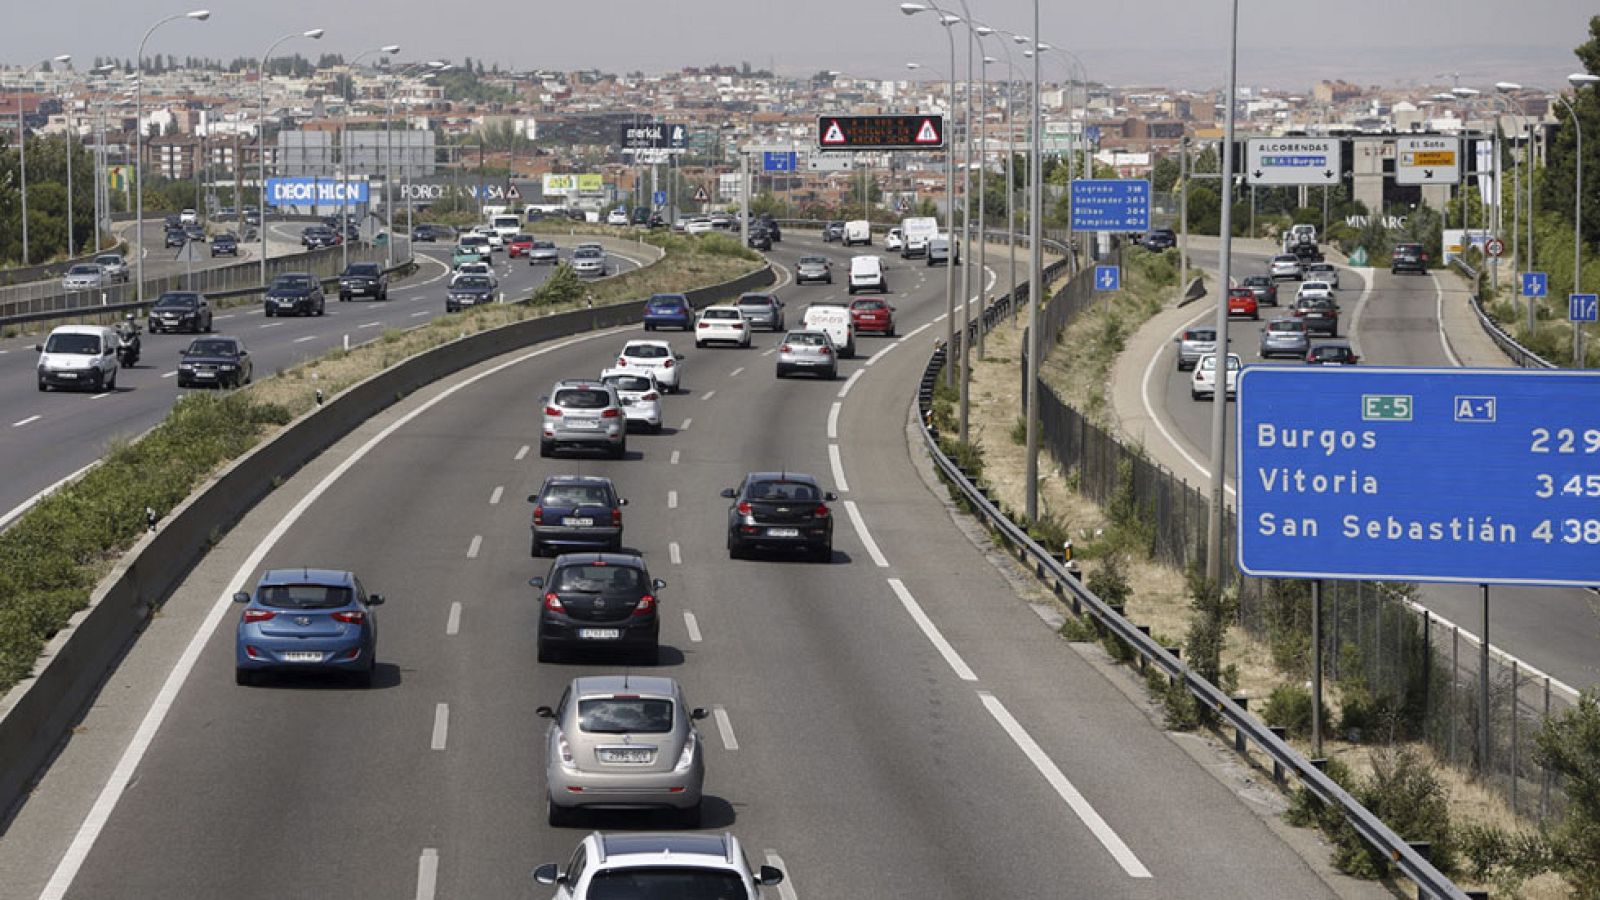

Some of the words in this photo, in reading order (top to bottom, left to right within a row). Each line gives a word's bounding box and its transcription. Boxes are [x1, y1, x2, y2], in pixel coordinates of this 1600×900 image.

[1259, 143, 1329, 152] ALCOBENDAS
[1075, 196, 1122, 204] Santander
[1074, 207, 1104, 215] Bilbao
[1074, 218, 1121, 227] Pamplona
[1366, 397, 1409, 418] E-5
[1457, 399, 1495, 419] A-1
[1257, 423, 1378, 456] Burgos
[1530, 428, 1600, 454] 229
[1258, 467, 1379, 495] Vitoria
[1535, 473, 1600, 498] 345
[1258, 512, 1319, 538] San
[1342, 514, 1517, 544] Sebastián
[1531, 519, 1600, 545] 438
